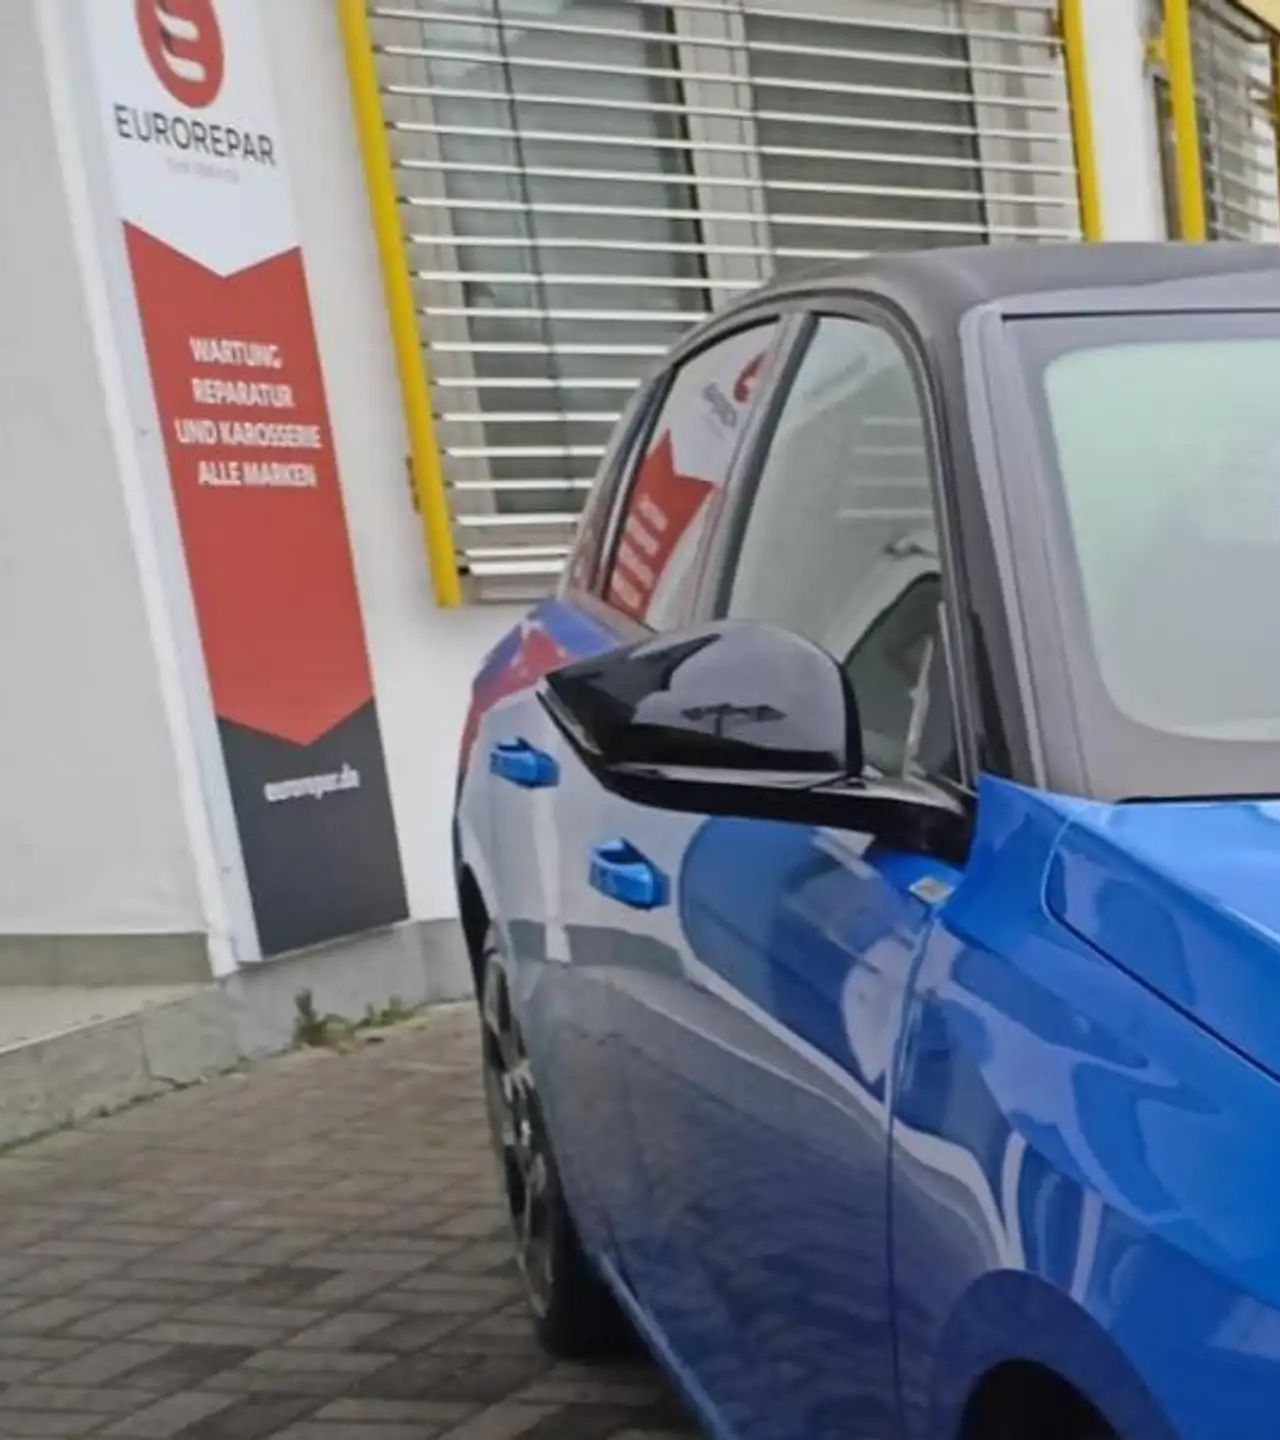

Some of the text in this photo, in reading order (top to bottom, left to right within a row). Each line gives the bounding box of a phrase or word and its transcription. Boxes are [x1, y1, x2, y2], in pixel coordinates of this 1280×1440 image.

[113, 103, 277, 167] EUROREPAR
[189, 337, 283, 369] WARTUNG
[191, 377, 296, 408] REPARATUR
[173, 417, 323, 448] UND KAROSSERIE
[198, 460, 317, 488] ALLE MARKEN
